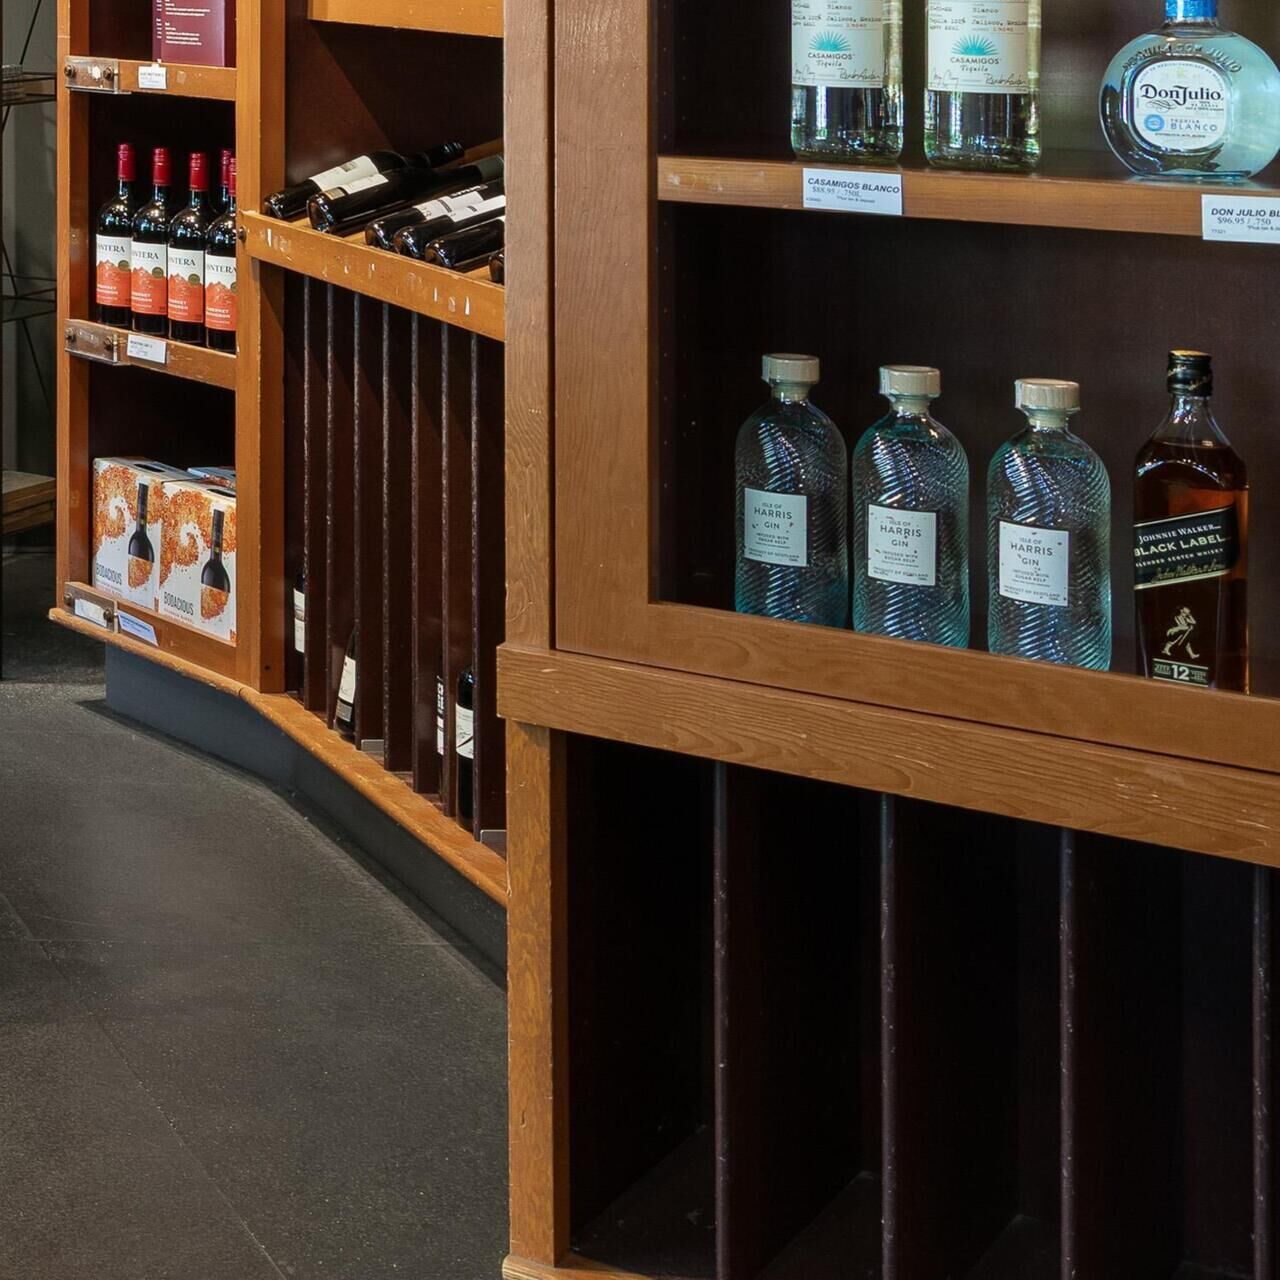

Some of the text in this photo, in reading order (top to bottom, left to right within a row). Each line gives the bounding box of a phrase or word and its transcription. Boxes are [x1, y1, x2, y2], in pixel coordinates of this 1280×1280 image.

[807, 52, 853, 61] CASAMIGOS
[950, 57, 1000, 65] CASAMIGOS
[816, 60, 843, 68] Tequila
[960, 64, 989, 73] Tequila
[1170, 123, 1218, 132] BLANCO
[807, 177, 900, 194] CASAMIGOS BLANCO
[1211, 207, 1234, 216] DON
[1236, 208, 1267, 217] JULIO
[1217, 216, 1245, 225] $96.95
[753, 507, 793, 520] HARRIS
[764, 521, 781, 530] GIN
[880, 524, 922, 538] HARRIS
[1139, 523, 1215, 544] JOHNNIE WALKER
[891, 538, 909, 548] GIN
[1133, 533, 1225, 557] BLACK LABEL
[1011, 542, 1053, 557] HARRIS
[1022, 557, 1039, 567] GIN
[95, 562, 123, 586] BODACIOUS
[163, 591, 194, 616] BODACIOUS
[1171, 663, 1190, 681] 12
